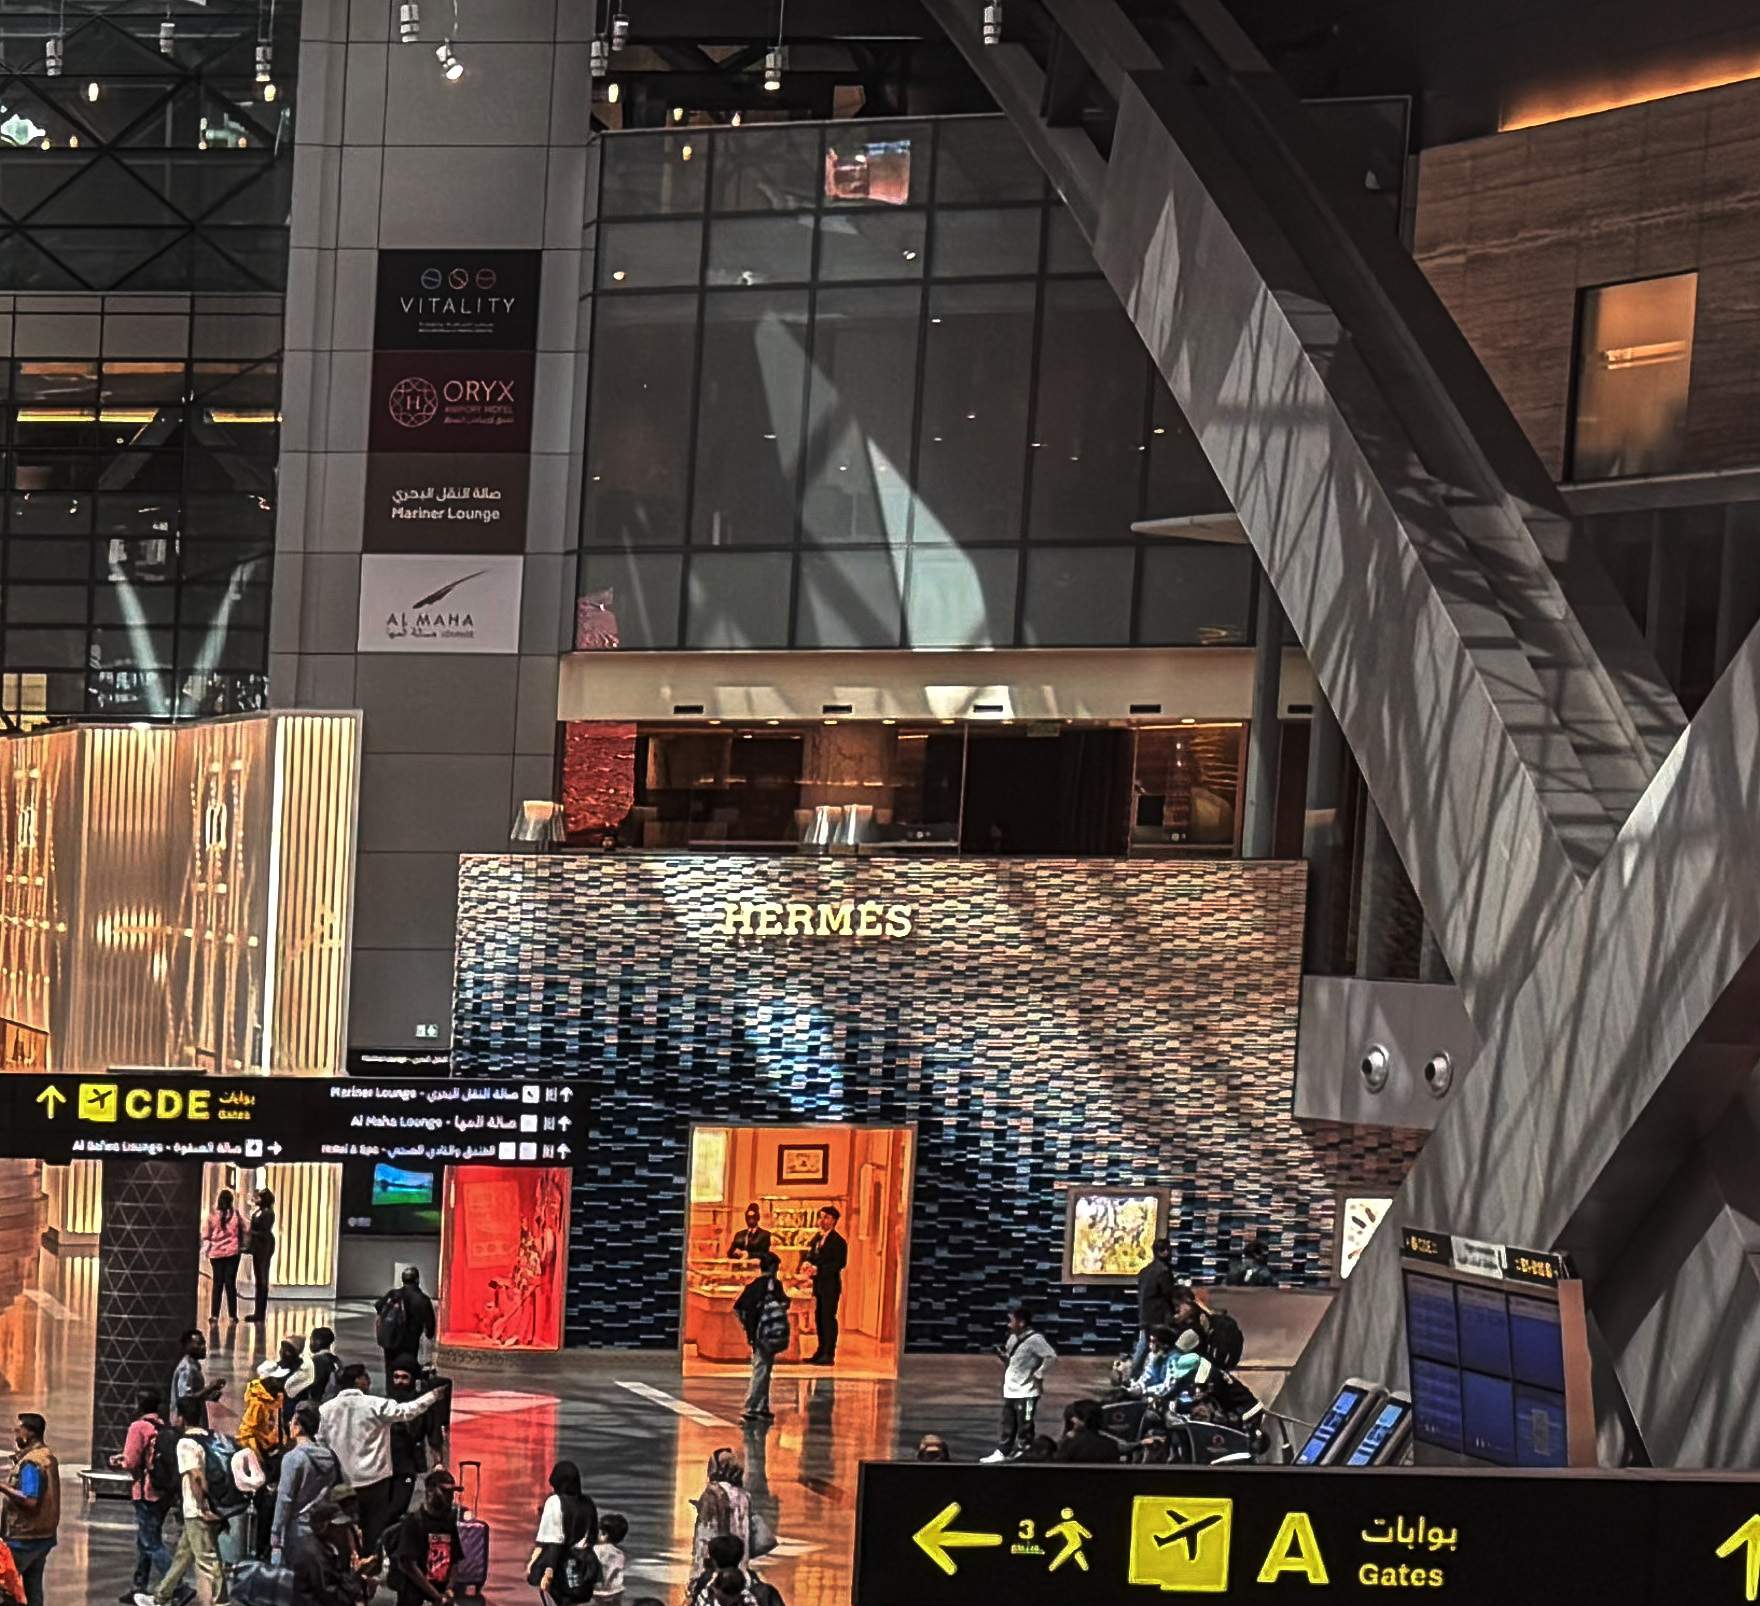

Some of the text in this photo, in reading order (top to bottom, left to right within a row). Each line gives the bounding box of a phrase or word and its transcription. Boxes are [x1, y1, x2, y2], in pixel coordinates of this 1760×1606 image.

[400, 297, 515, 314] VITALITY
[443, 380, 515, 402] ORYX
[392, 487, 501, 503] صالة النقل البحري
[392, 507, 501, 523] Mariner Lounge
[387, 612, 474, 626] AL MAHA
[125, 1088, 211, 1120] CDE
[1018, 1519, 1035, 1540] 3
[1360, 1516, 1458, 1552] بوابات
[1256, 1512, 1329, 1584] A
[1359, 1564, 1445, 1587] Gates
